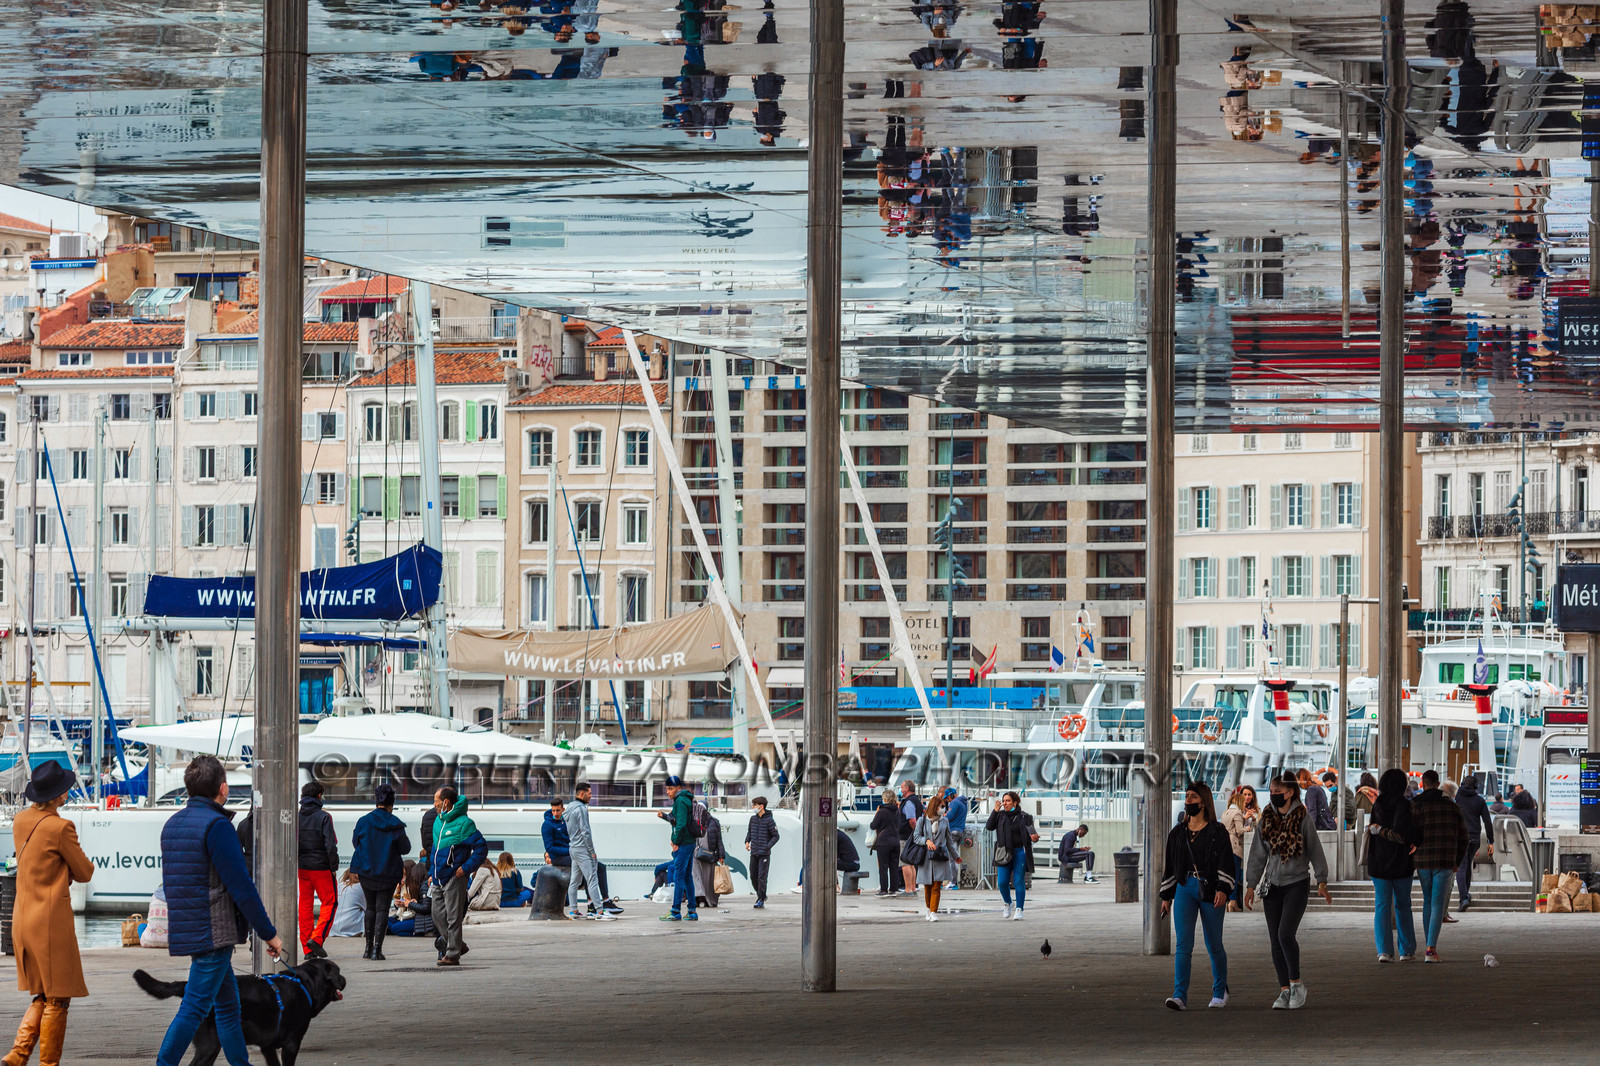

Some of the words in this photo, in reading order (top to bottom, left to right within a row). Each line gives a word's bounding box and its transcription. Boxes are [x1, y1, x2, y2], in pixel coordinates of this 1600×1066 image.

[685, 377, 806, 390] HTEL
[904, 615, 940, 629] ÔTEL
[504, 650, 687, 675] WWW.LEVANTIN.FR
[864, 697, 882, 706] Venez
